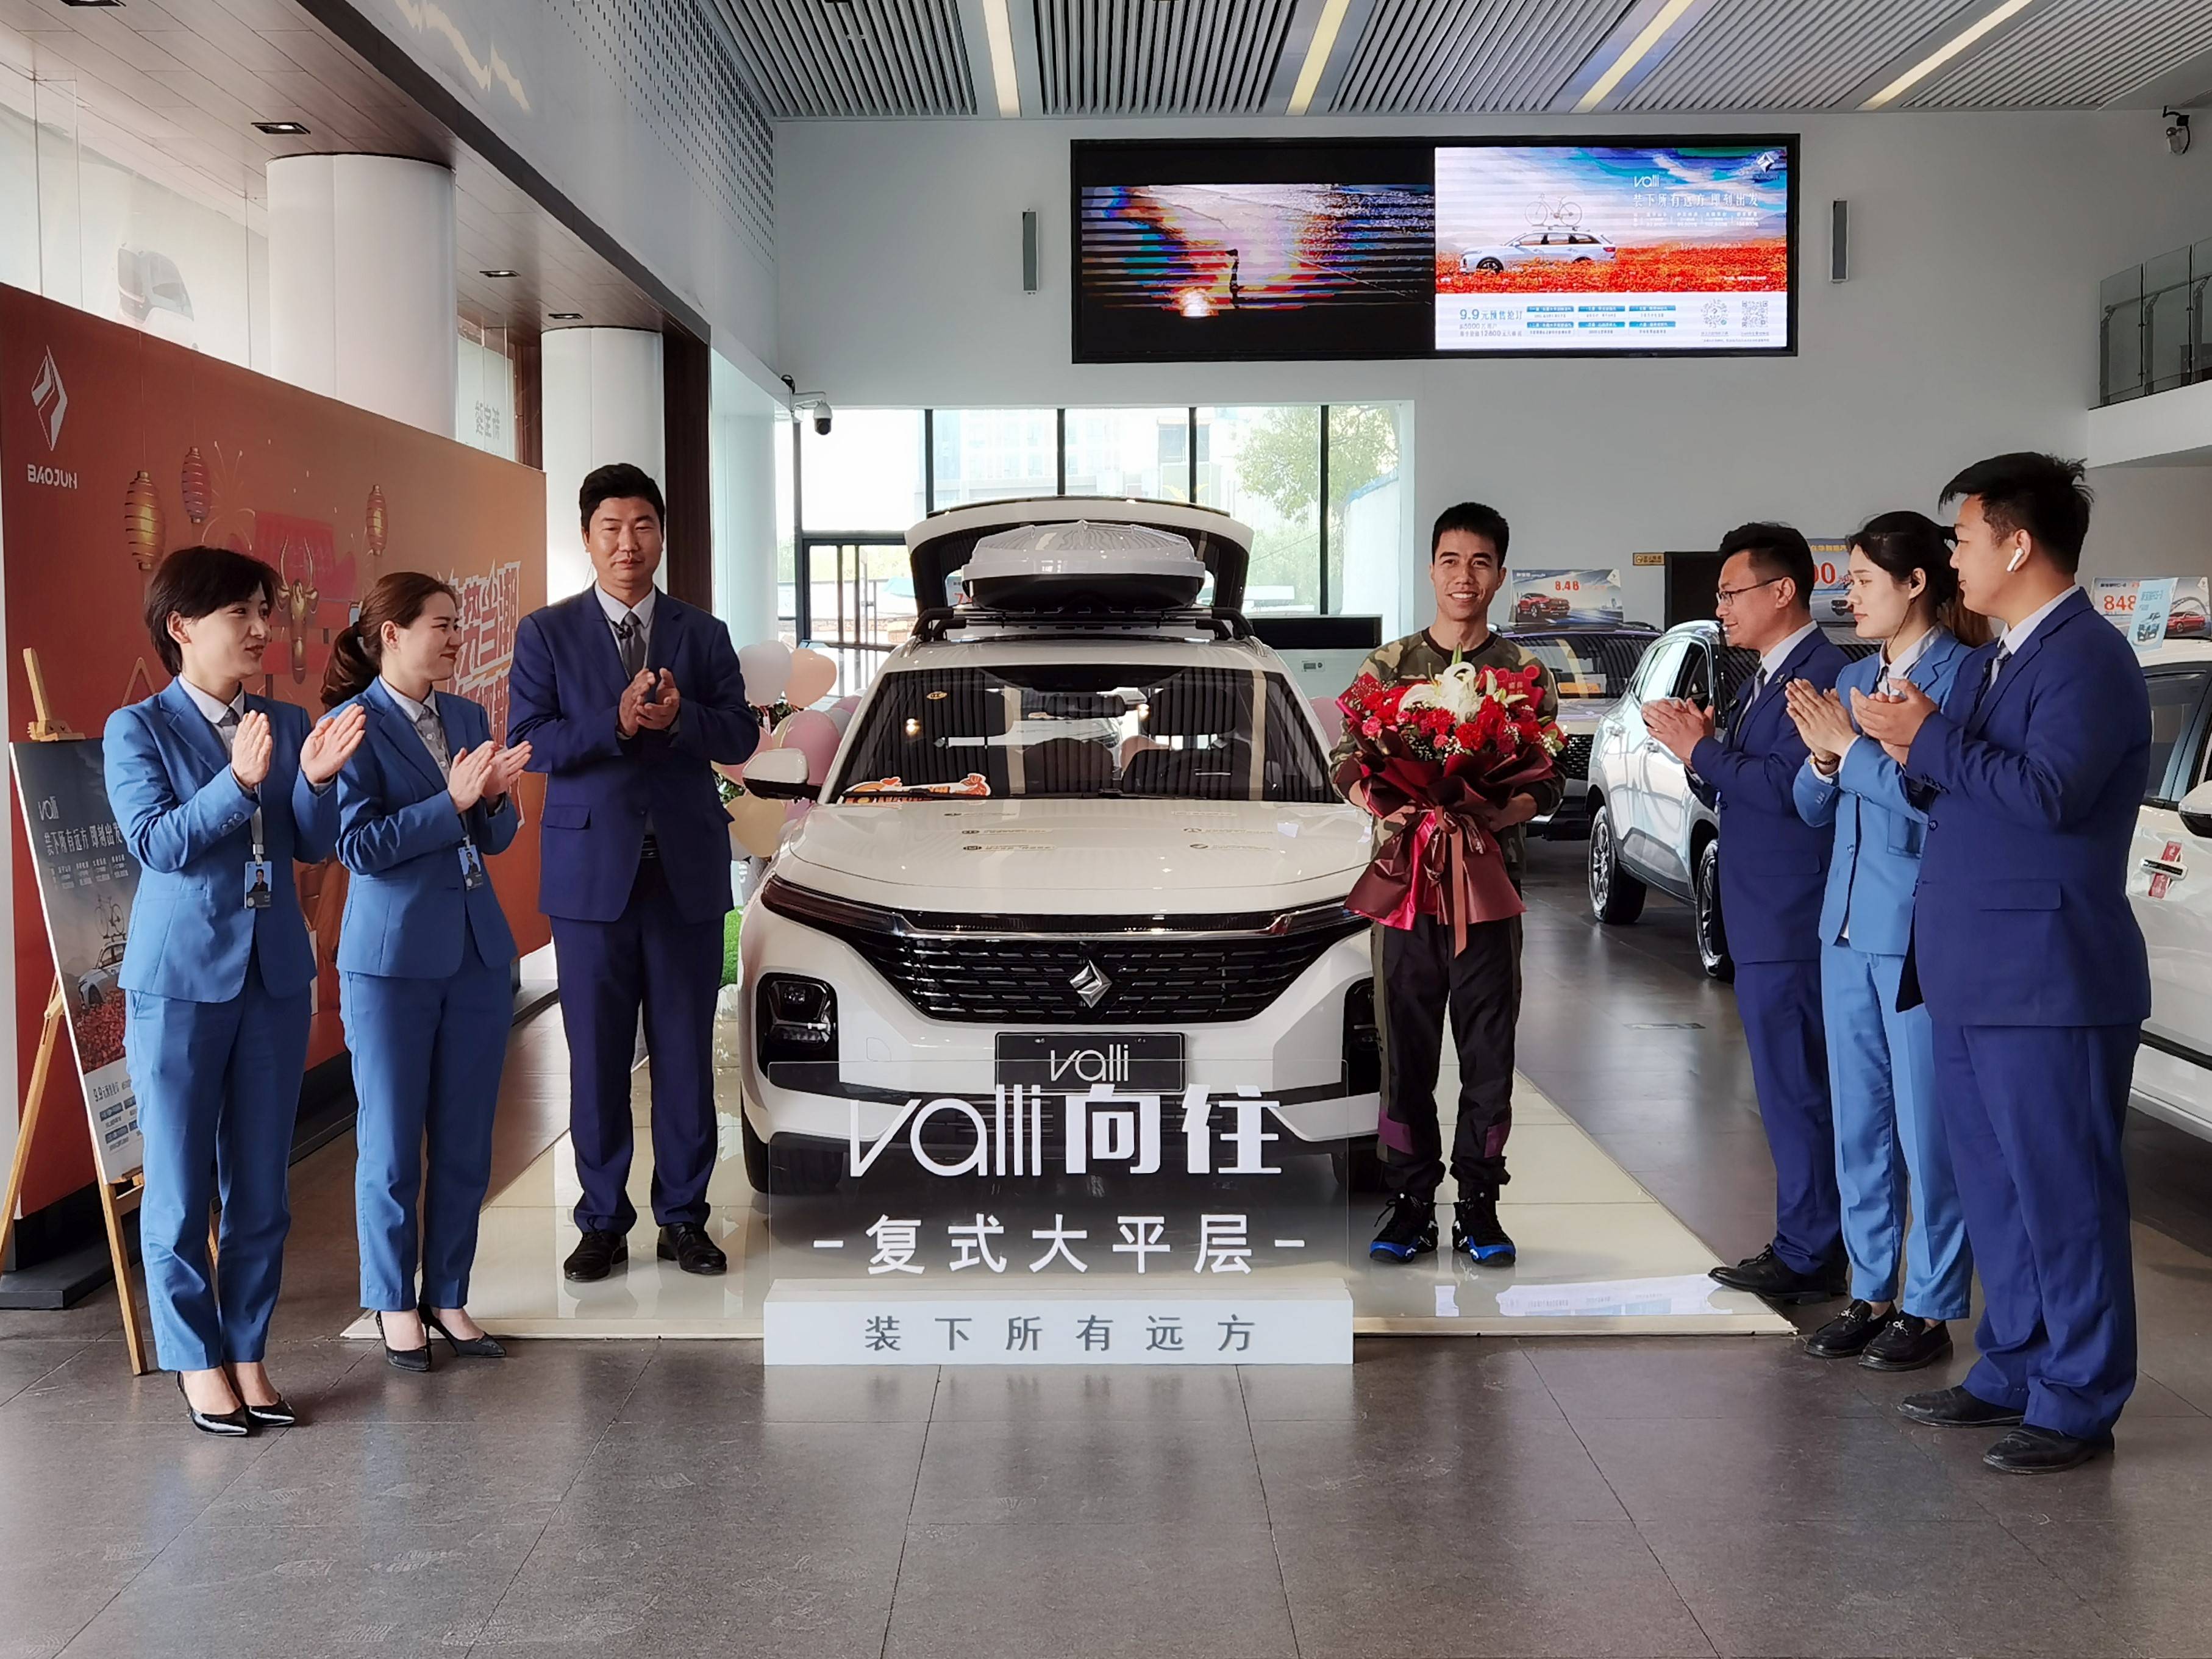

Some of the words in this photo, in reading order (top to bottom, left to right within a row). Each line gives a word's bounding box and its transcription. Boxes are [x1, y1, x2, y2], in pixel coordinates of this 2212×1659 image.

[27, 463, 78, 490] BAOJUN
[1555, 580, 1580, 591] 8.48
[2103, 594, 2137, 612] 848
[1049, 1044, 1130, 1083] valli
[849, 1083, 1042, 1177] valli
[1065, 1083, 1282, 1175] 向往
[864, 1314, 1256, 1354] 装下所有远方
